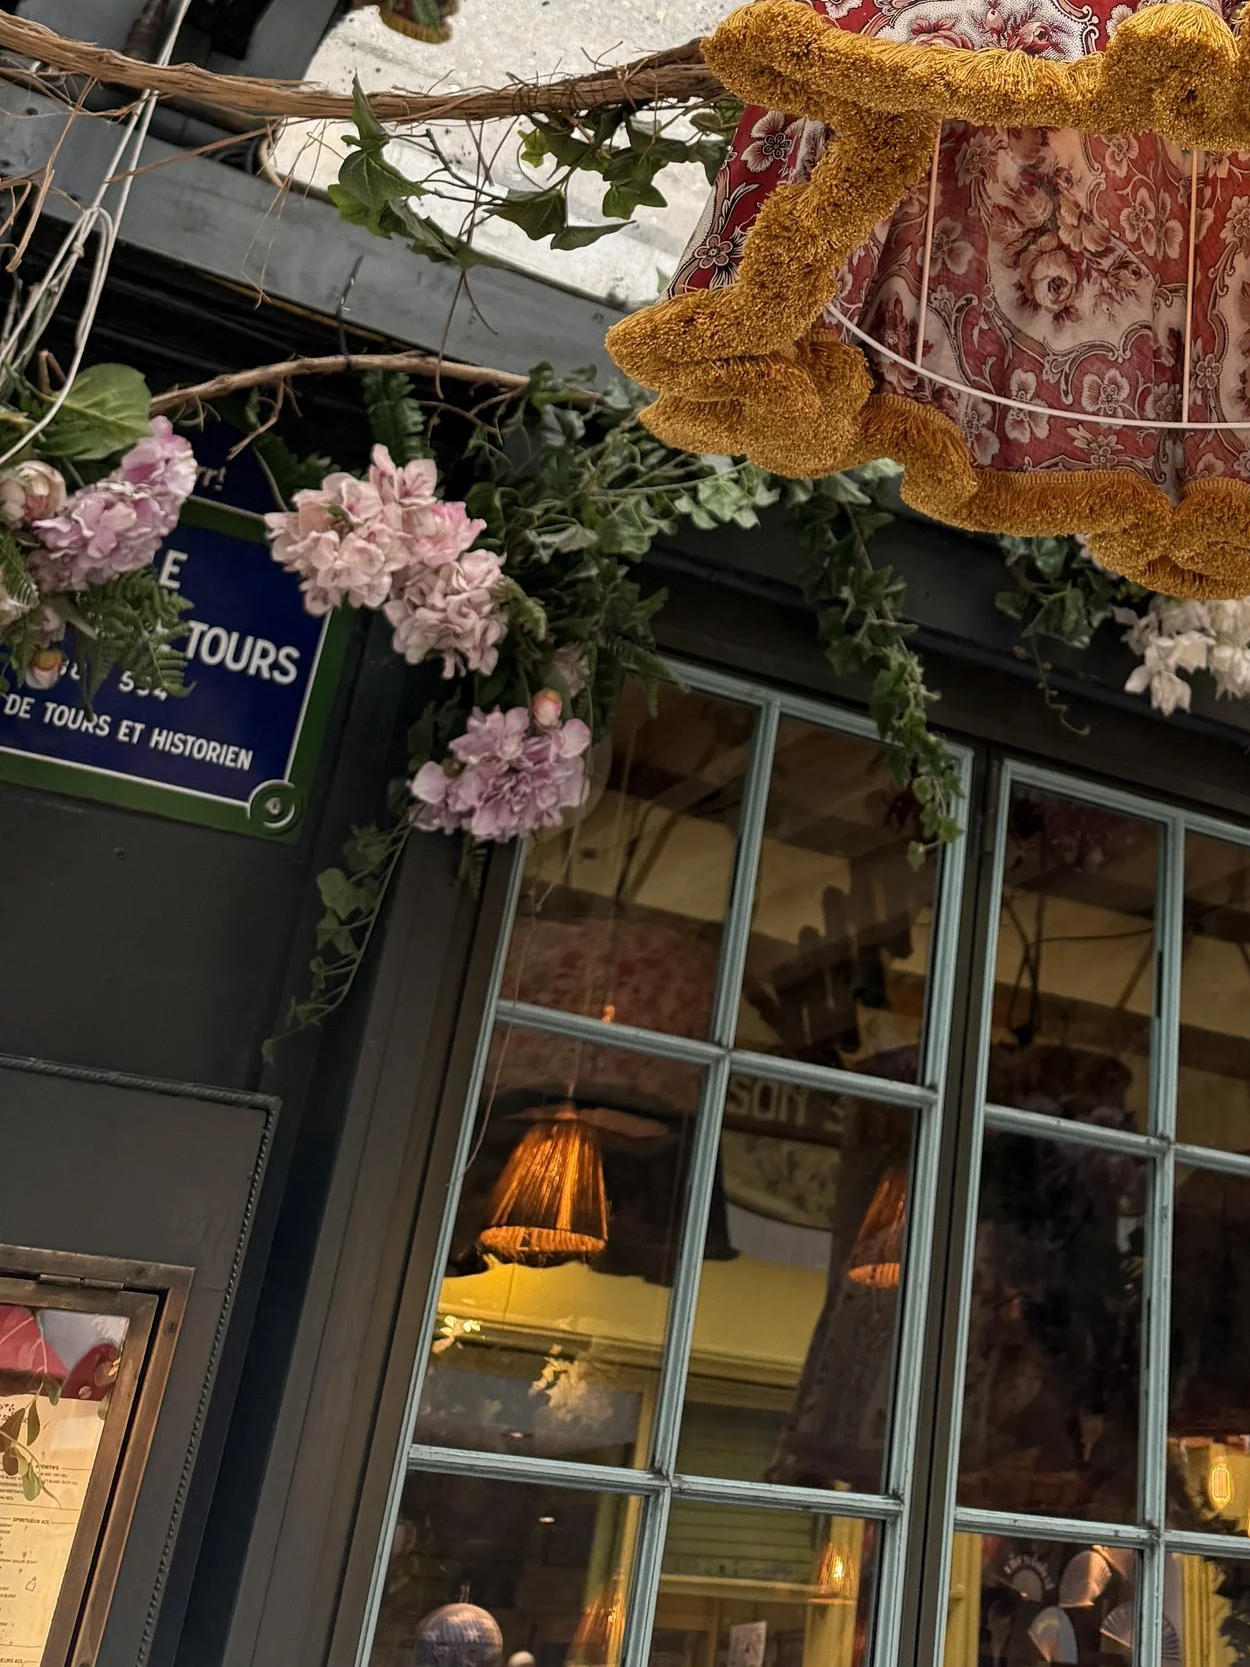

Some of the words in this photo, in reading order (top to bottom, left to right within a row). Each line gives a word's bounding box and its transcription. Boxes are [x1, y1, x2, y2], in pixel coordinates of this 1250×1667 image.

[186, 620, 300, 685] TOURS
[4, 693, 35, 719] DE
[44, 701, 111, 735] TOURS
[118, 719, 146, 744] ET
[150, 727, 253, 771] HISTORIEN
